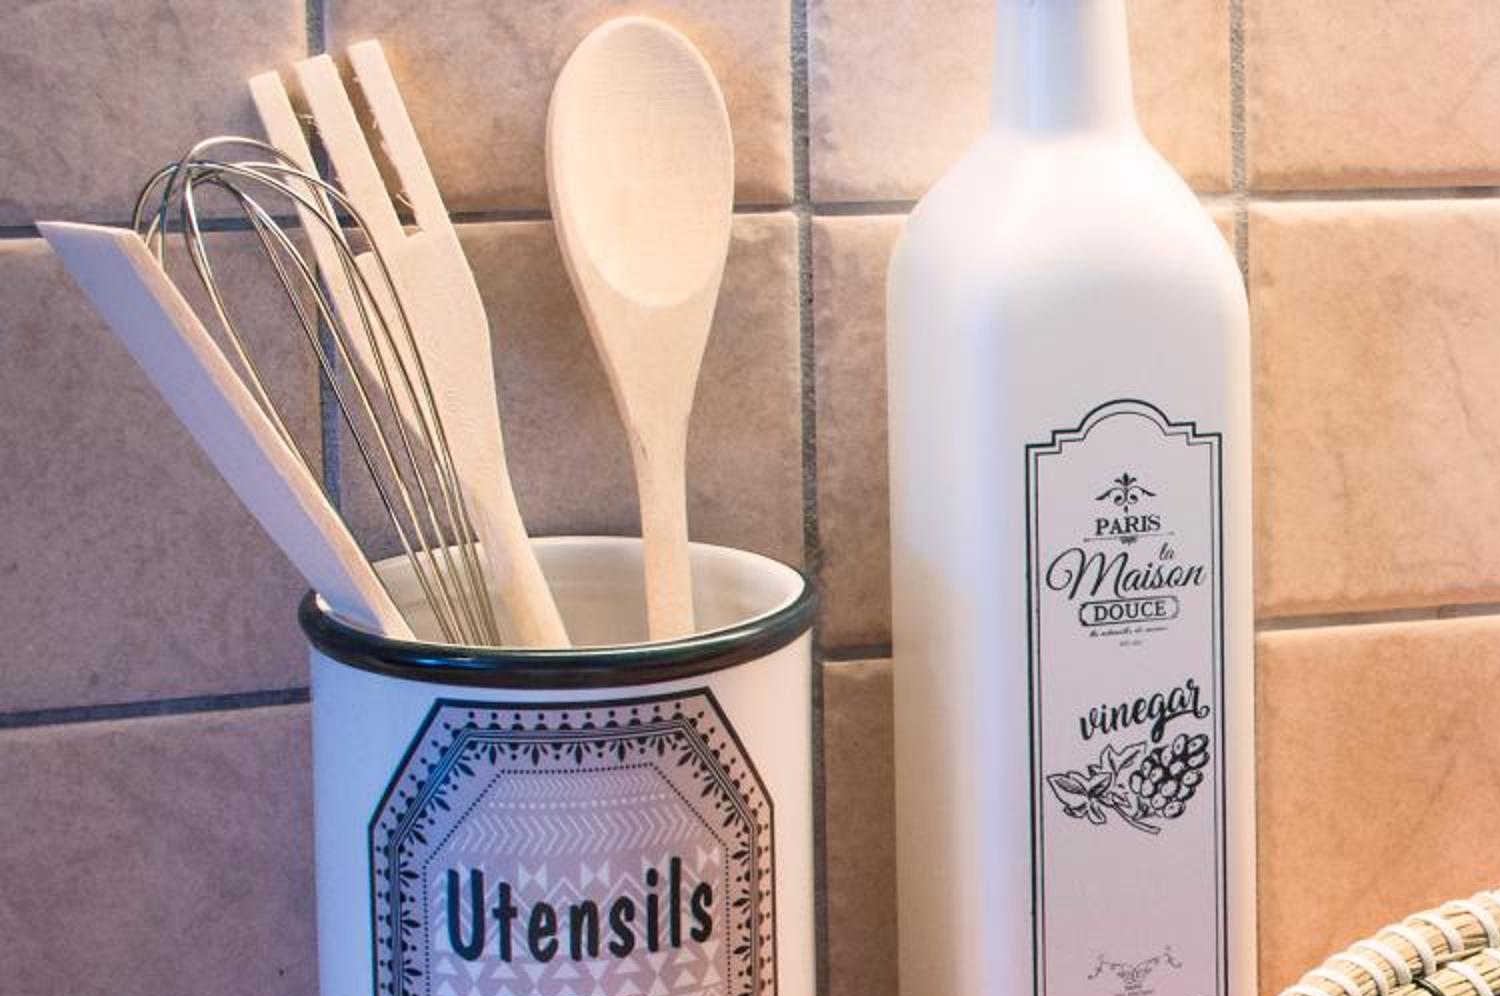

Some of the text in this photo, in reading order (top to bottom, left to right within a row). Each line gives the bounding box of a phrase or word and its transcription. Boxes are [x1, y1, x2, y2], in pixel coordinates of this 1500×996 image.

[1095, 514, 1161, 536] PARIS
[1159, 542, 1175, 561] la
[1046, 547, 1204, 600] Maison
[1093, 601, 1168, 623] DOUCE
[1079, 678, 1210, 743] vinegar
[447, 856, 713, 962] Utensils
